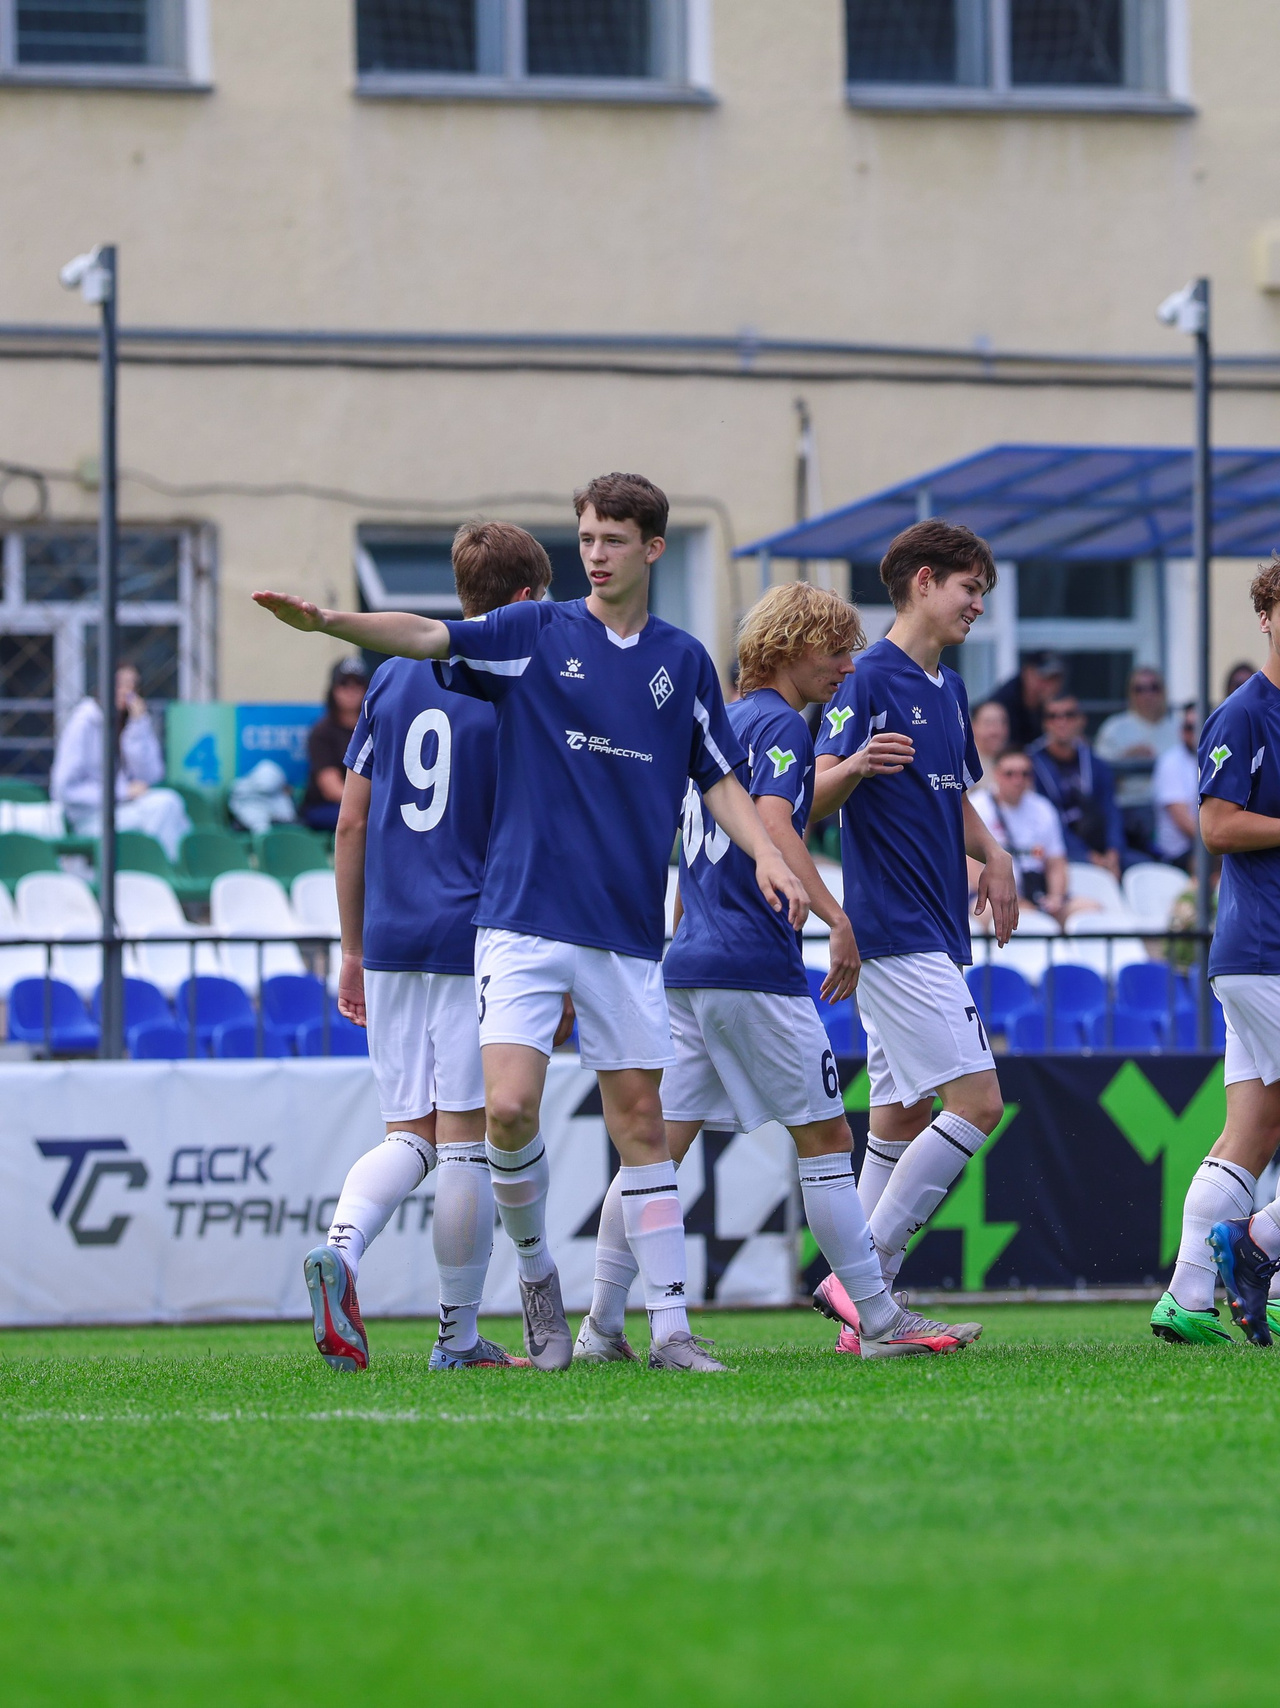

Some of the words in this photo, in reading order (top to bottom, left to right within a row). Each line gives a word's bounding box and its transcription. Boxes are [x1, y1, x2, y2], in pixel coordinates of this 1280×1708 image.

[560, 670, 585, 680] KELME
[183, 733, 221, 786] 4
[400, 708, 452, 832] 9
[588, 744, 653, 763] ТРАНССТРОЙ
[963, 1005, 987, 1051] 7
[821, 1048, 838, 1099] 6
[168, 1146, 274, 1186] ДСК
[440, 1354, 448, 1363] 9
